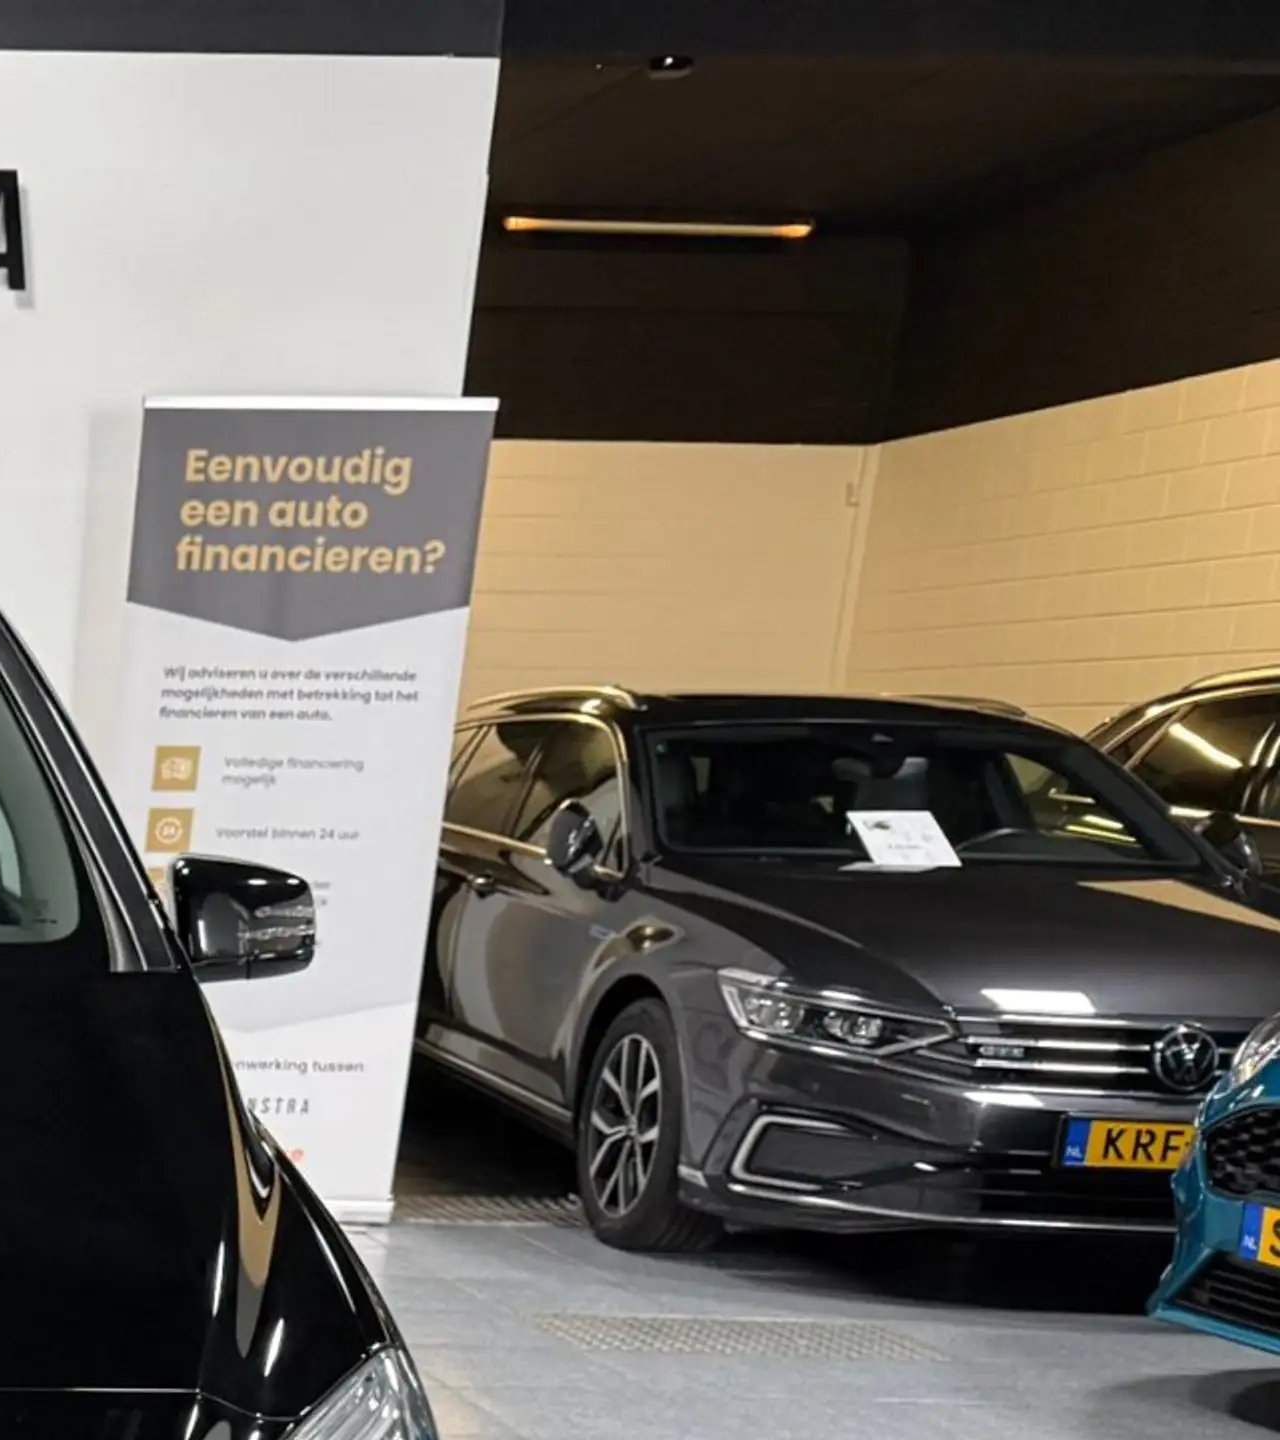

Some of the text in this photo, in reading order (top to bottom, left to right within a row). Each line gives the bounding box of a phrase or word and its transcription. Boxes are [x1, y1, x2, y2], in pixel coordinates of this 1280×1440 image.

[185, 447, 413, 495] Eenvoudig
[180, 496, 369, 528] een auto
[175, 535, 446, 575] financieren?
[266, 688, 294, 700] met
[236, 1058, 364, 1075] nwerking tussen
[247, 1097, 310, 1115] NSTRA
